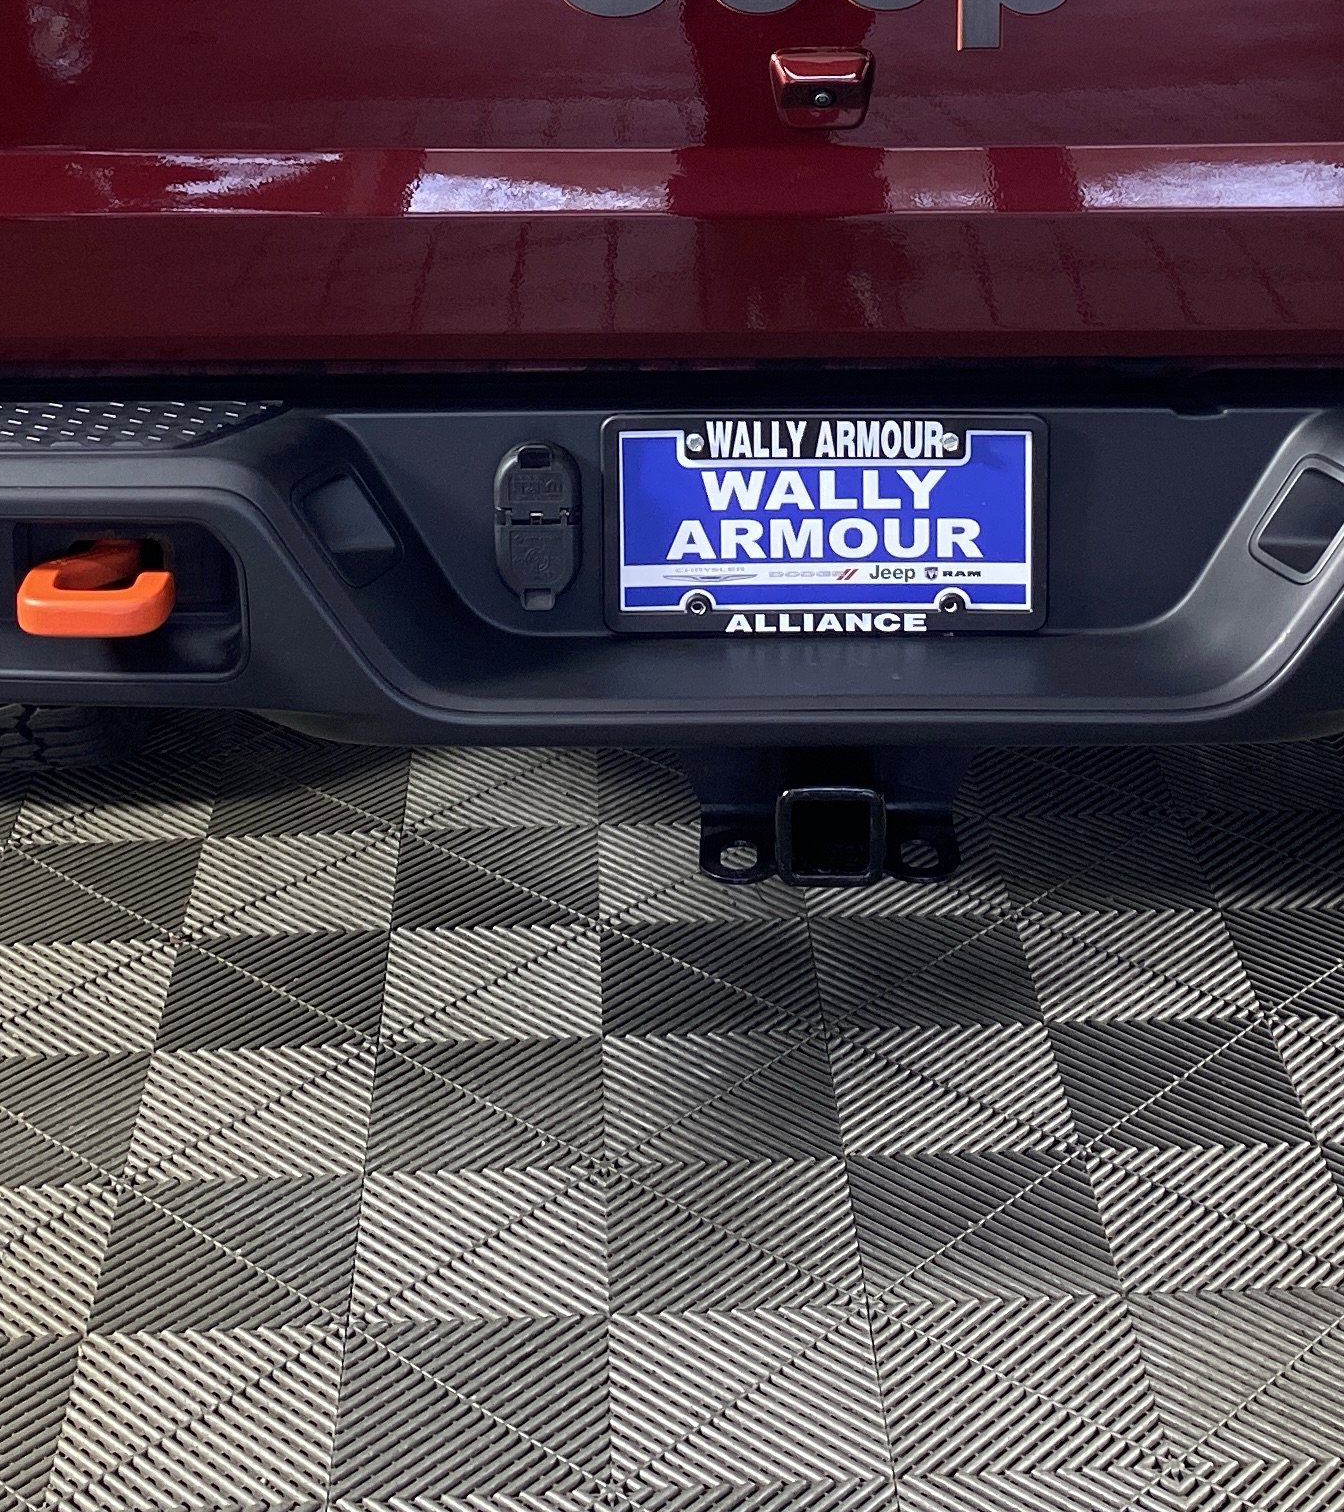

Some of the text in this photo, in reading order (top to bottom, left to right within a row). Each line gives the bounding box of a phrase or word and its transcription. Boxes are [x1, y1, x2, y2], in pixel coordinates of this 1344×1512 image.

[706, 420, 944, 458] WALLY ARMOUR
[701, 470, 947, 511] WALLY
[665, 518, 984, 561] ARMOUR
[674, 566, 746, 574] CHRYSLER
[869, 565, 916, 583] Jeep
[724, 614, 927, 633] ALLIANCE
